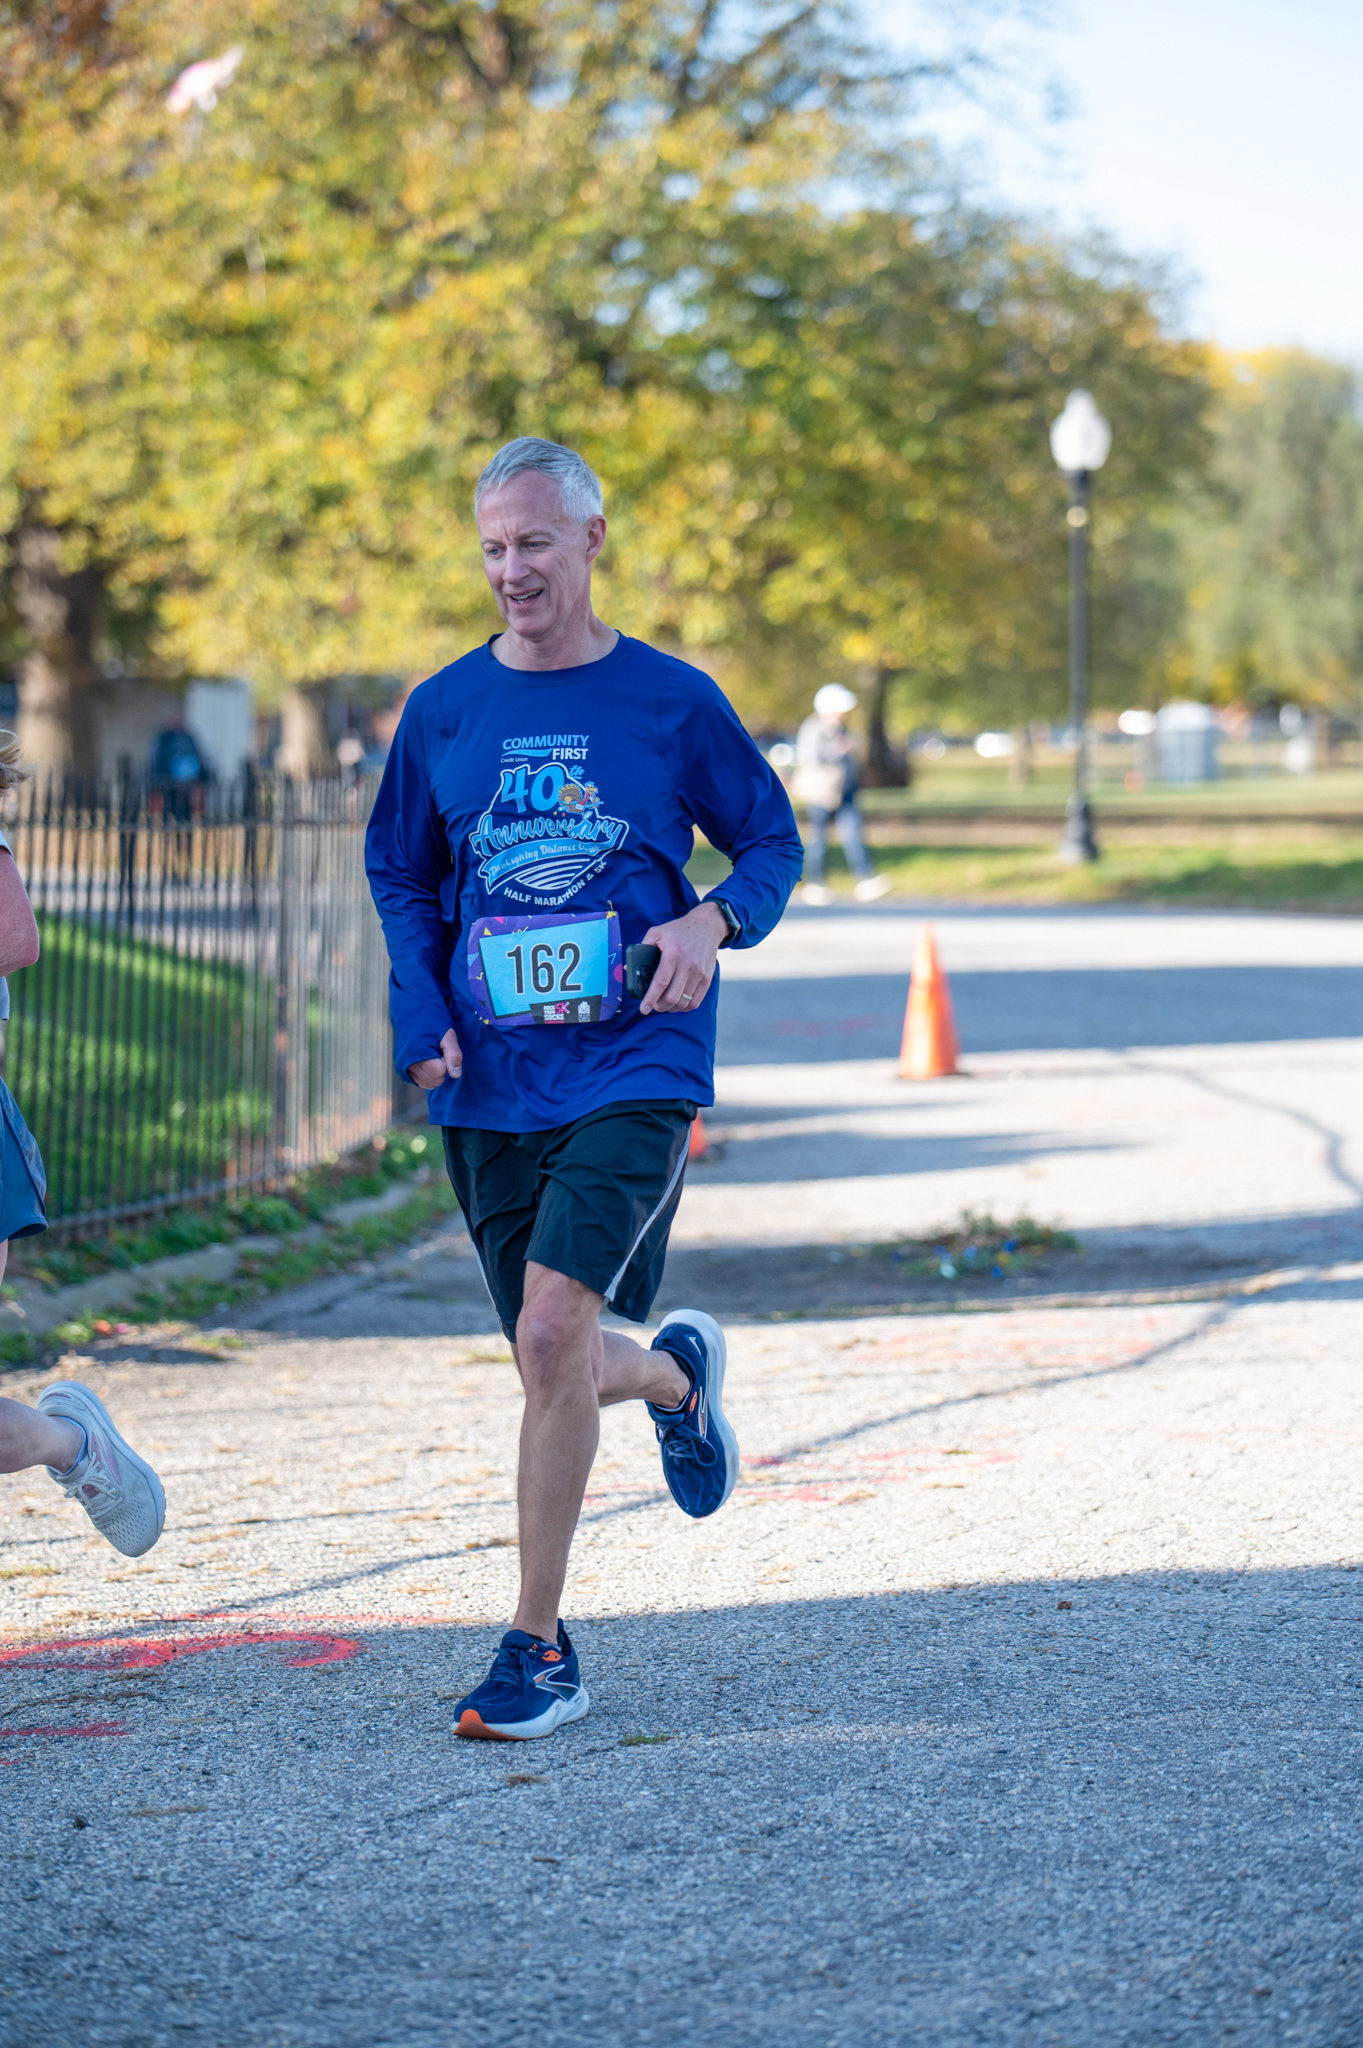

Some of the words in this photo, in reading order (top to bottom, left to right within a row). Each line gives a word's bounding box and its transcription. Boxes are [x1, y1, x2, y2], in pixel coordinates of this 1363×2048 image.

[502, 734, 590, 750] COMMUNITY
[552, 747, 589, 761] FIRST
[471, 814, 623, 857] Anniversary
[539, 844, 576, 855] Distance
[503, 887, 532, 903] HALF
[534, 879, 586, 907] MARATHON
[586, 872, 595, 881] &
[593, 860, 607, 874] 5K
[506, 942, 583, 995] 162
[555, 1001, 570, 1014] 5K
